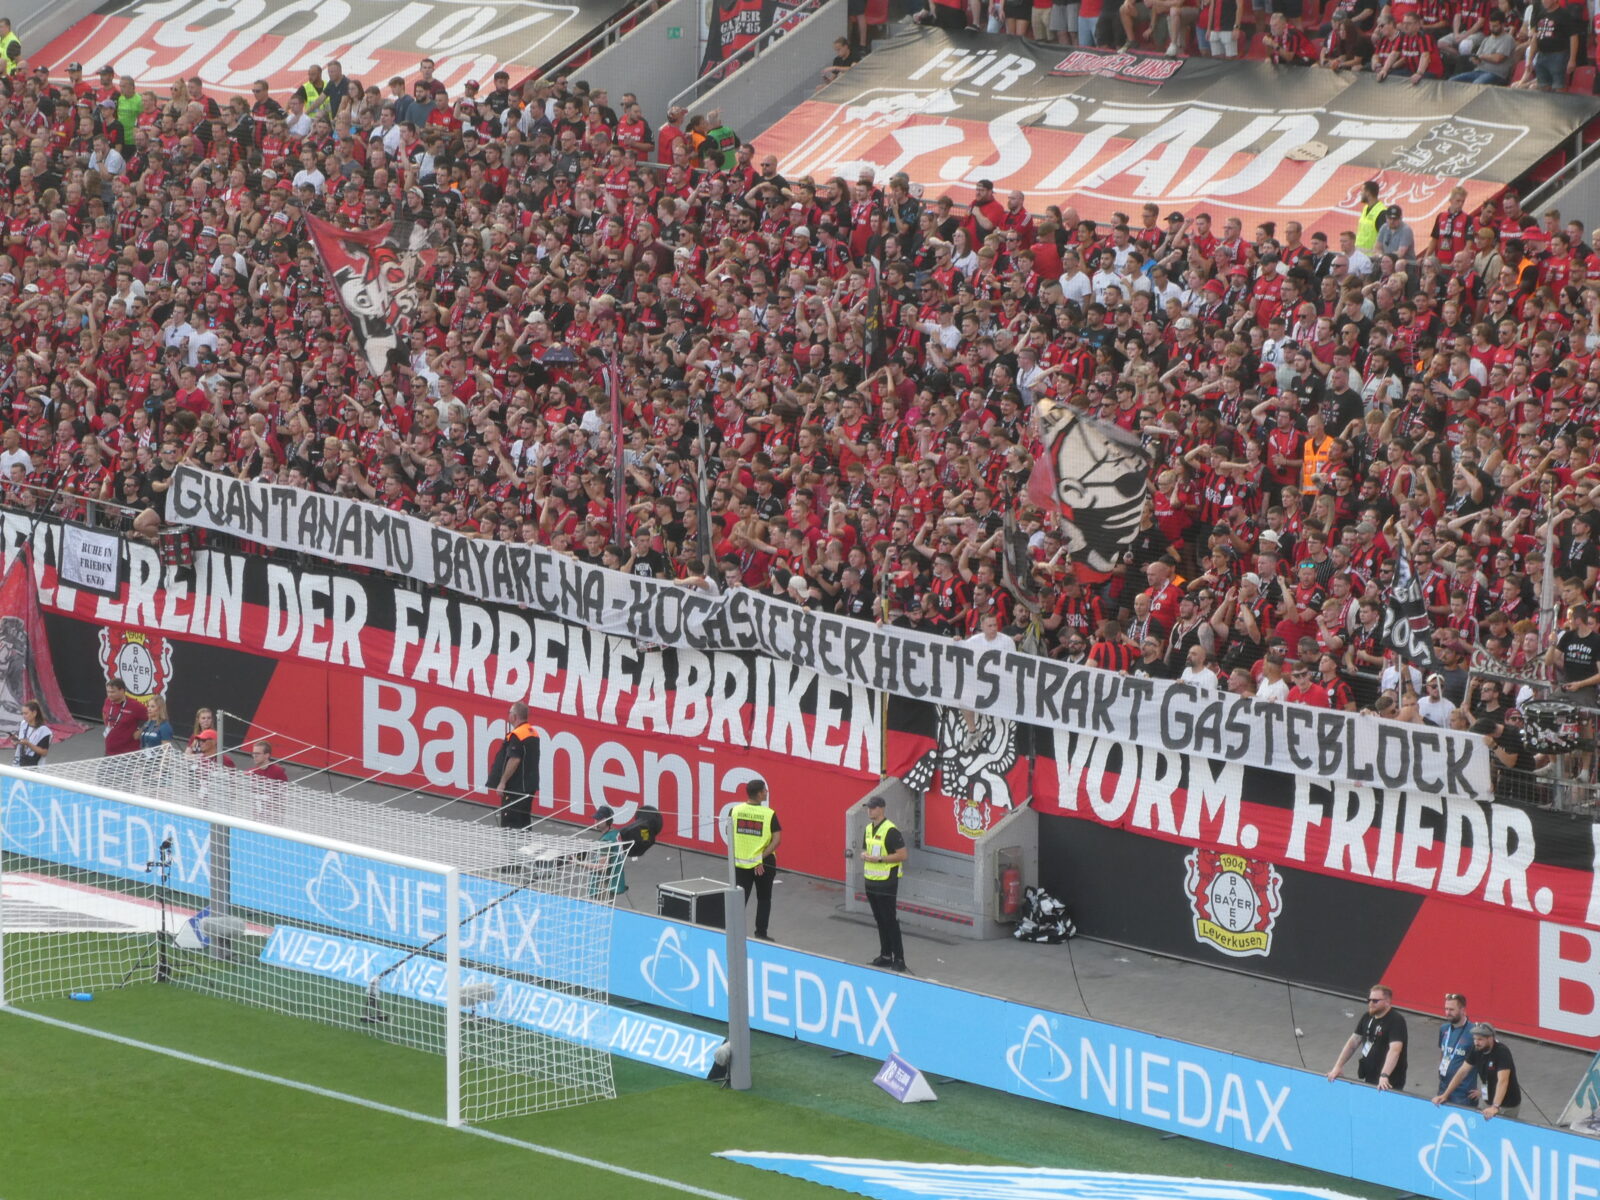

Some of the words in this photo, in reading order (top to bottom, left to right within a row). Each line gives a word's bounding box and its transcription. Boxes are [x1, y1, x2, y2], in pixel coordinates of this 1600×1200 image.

[908, 47, 1036, 91] FÜR
[172, 466, 414, 573] GUANTANAMO
[263, 564, 367, 669] DER
[388, 588, 883, 774] FARBENFABRIKEN
[1053, 727, 1259, 849] VORM.
[1285, 773, 1554, 915] FRIEDR.
[1222, 857, 1244, 870] 1904
[1214, 894, 1252, 911] BAYER
[1229, 876, 1237, 929] BAYER
[1202, 922, 1262, 949] Leverkusen
[266, 927, 379, 983] NIEDAX
[496, 984, 599, 1040] NIEDAX
[609, 1015, 718, 1073] NIEDAX
[1081, 1036, 1293, 1152] NIEDAX
